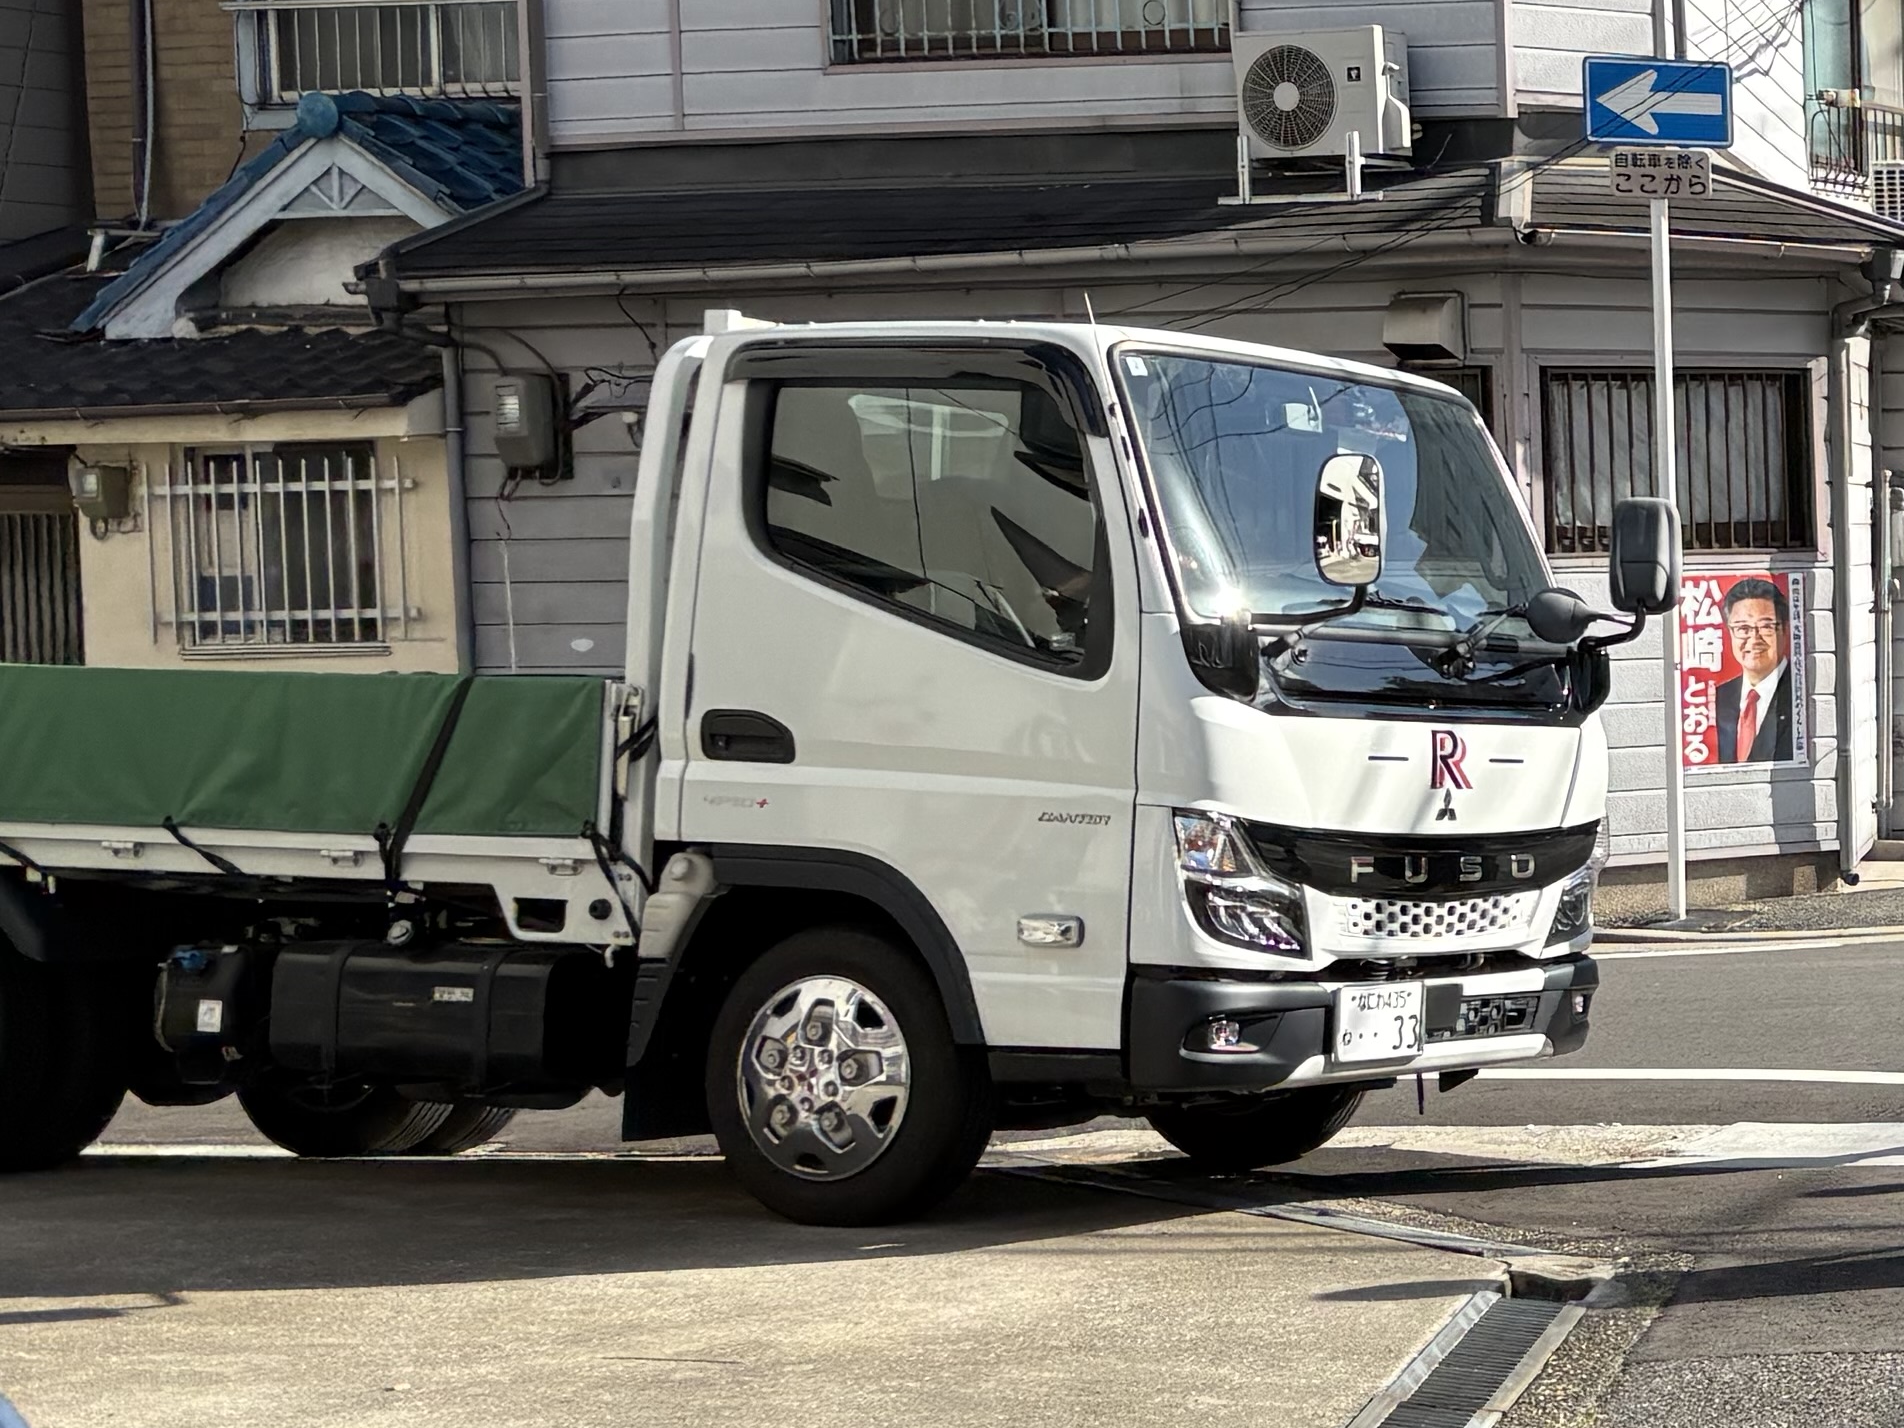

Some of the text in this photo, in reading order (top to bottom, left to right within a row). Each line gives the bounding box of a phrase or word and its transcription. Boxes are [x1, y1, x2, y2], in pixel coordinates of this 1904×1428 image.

[1614, 152, 1705, 170] 自転車を除く
[1615, 173, 1707, 195] ここから
[1350, 853, 1536, 884] FUSO
